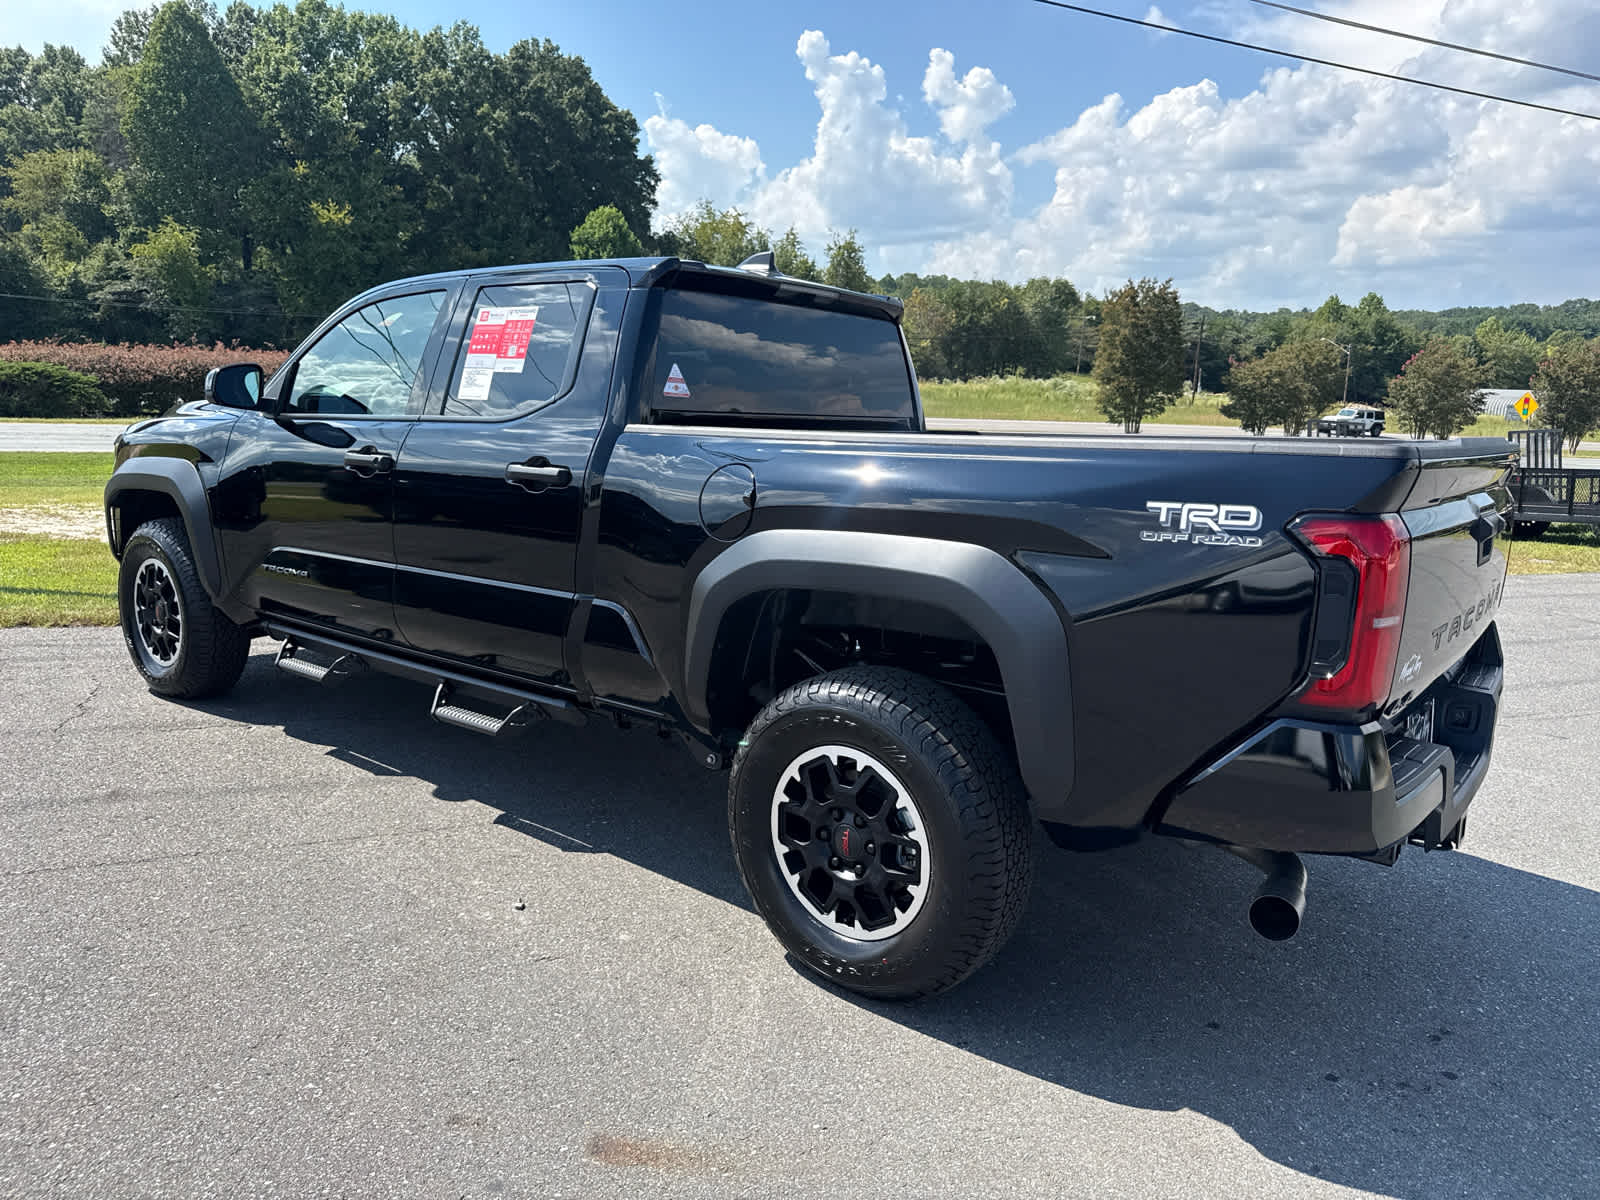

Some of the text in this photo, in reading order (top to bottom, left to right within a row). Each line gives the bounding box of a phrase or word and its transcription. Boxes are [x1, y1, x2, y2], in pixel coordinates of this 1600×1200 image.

[1146, 500, 1263, 535] TRD
[1139, 530, 1263, 548] OFF ROAD
